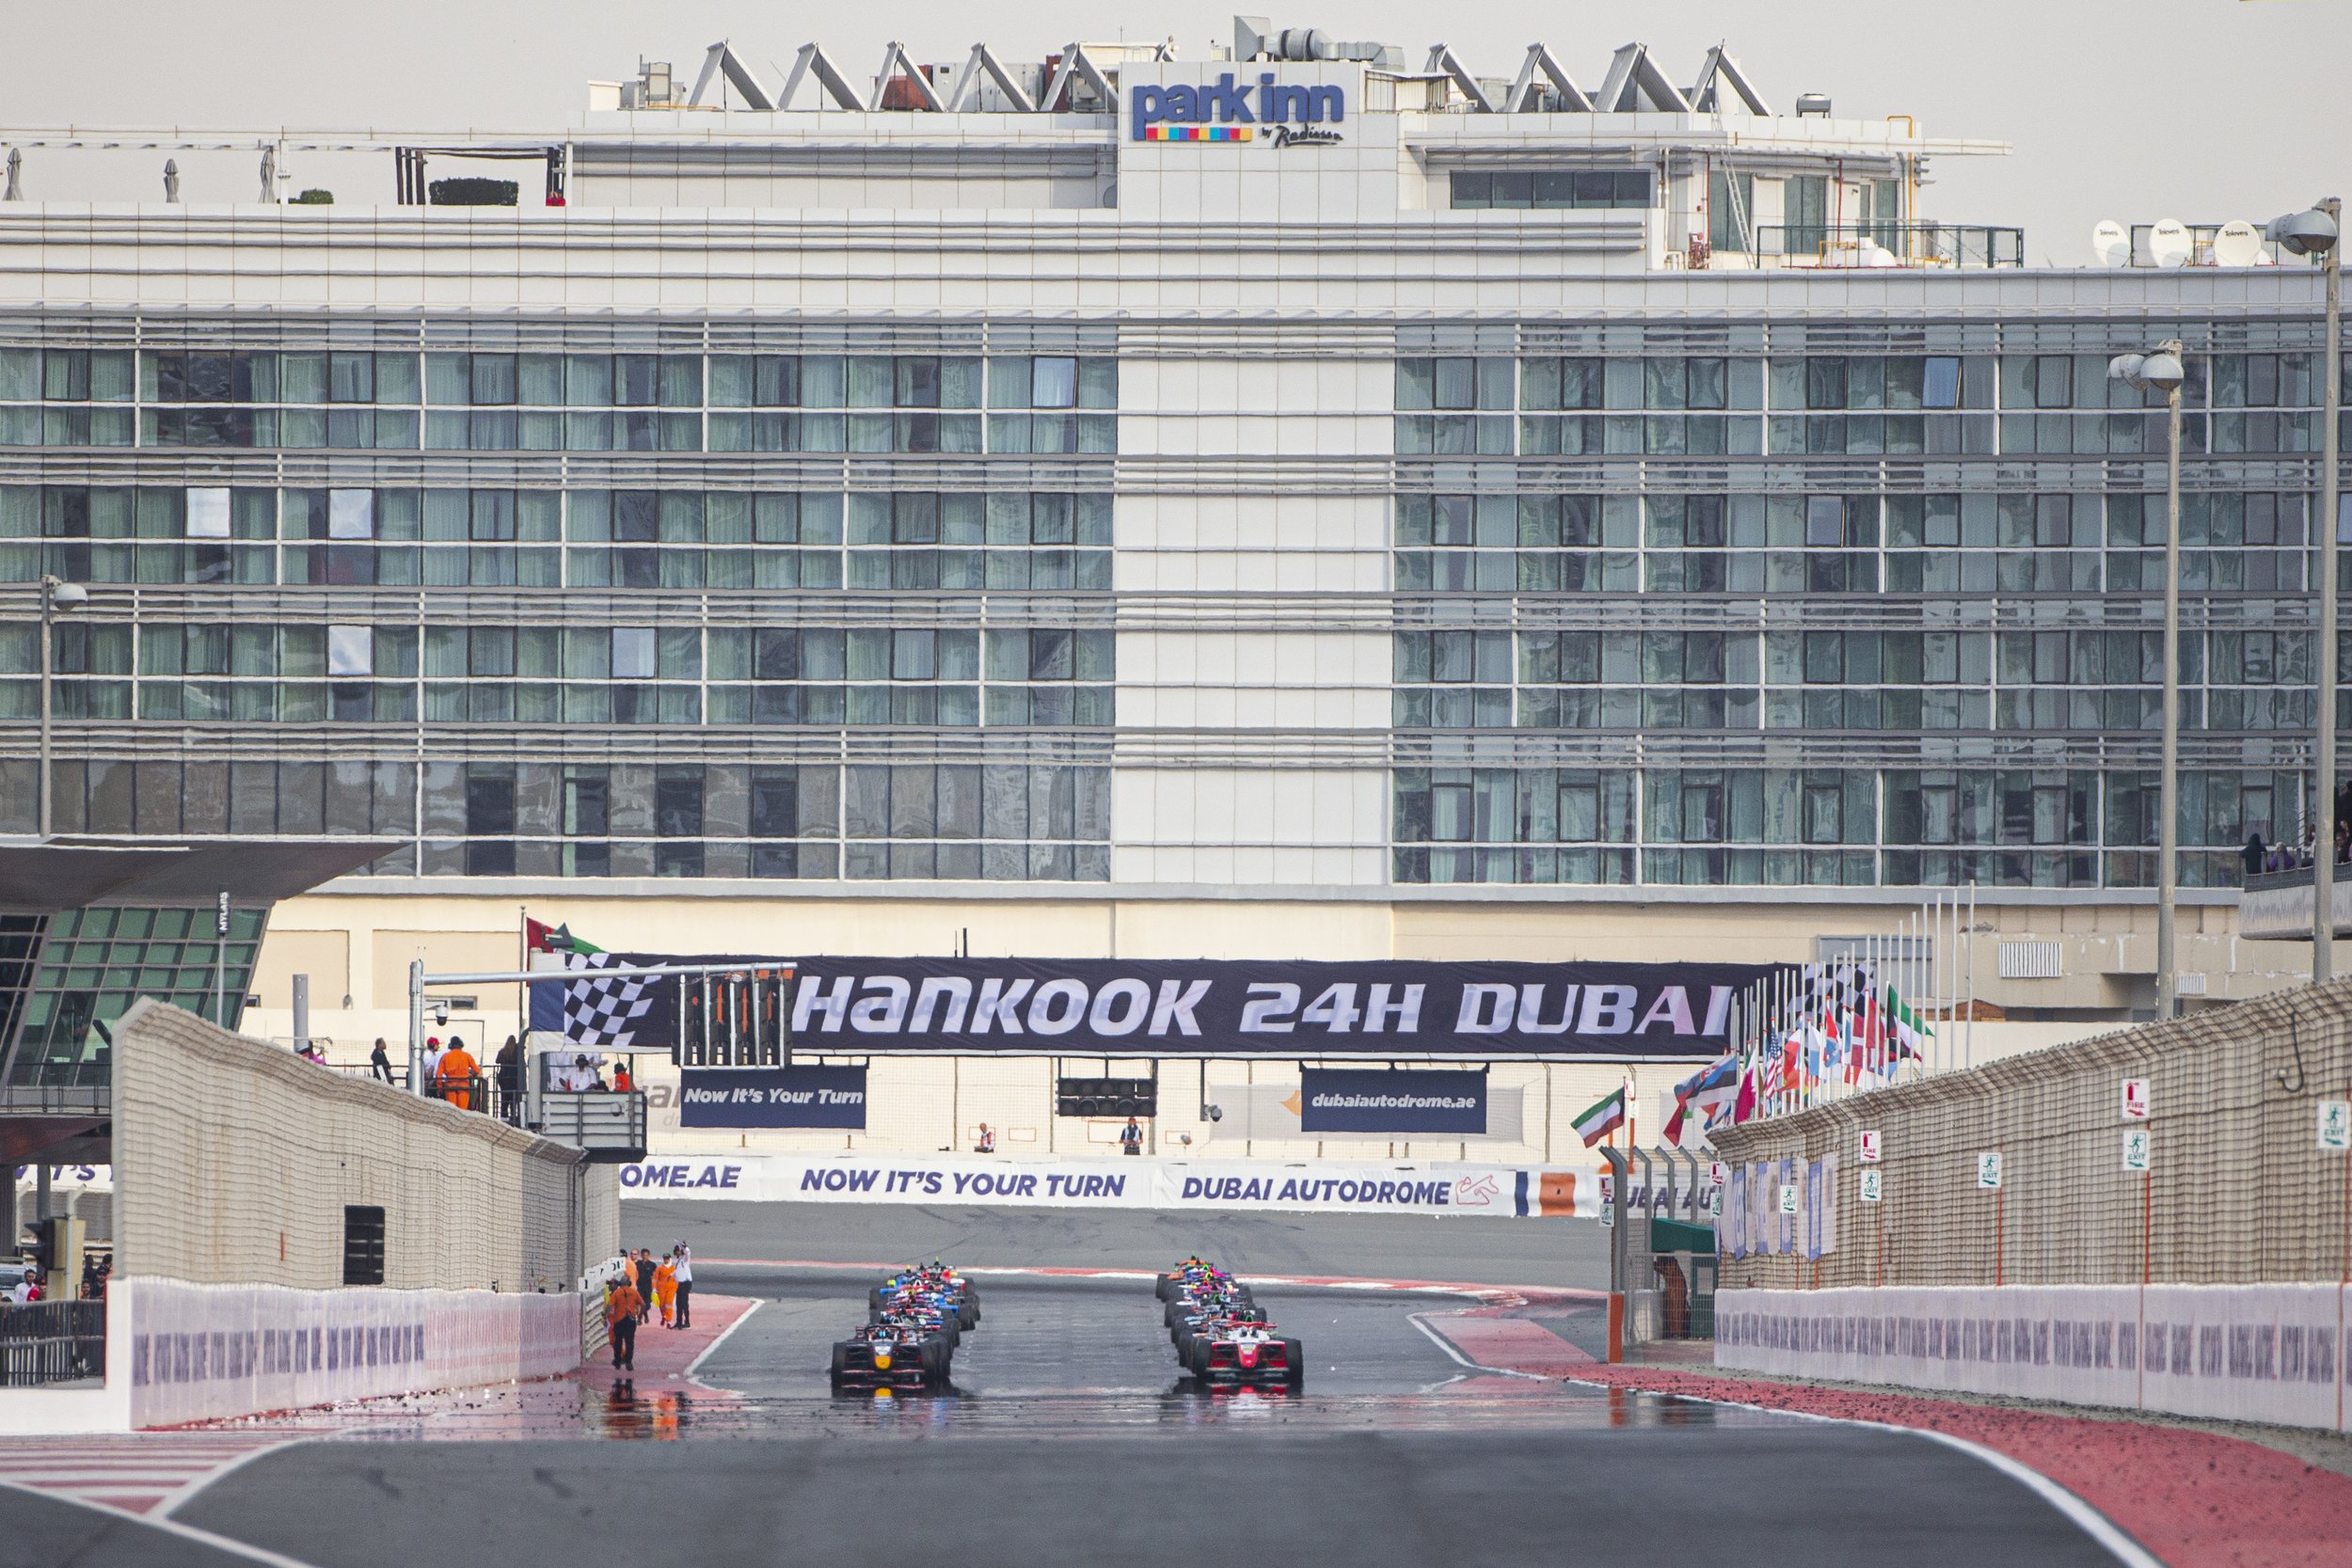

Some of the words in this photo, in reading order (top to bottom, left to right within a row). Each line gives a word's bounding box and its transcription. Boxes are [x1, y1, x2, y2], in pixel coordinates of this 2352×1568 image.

[1133, 72, 1255, 141] park
[1260, 72, 1343, 122] inn
[1261, 127, 1272, 138] by
[1239, 982, 1426, 1034] 24H
[1454, 982, 1734, 1037] DUBAI
[684, 1087, 729, 1103] Now
[732, 1087, 763, 1104] It's
[769, 1087, 813, 1104] Your
[818, 1088, 863, 1105] Turn
[1311, 1093, 1476, 1109] dubaiautodrome.ae
[801, 1168, 880, 1193] NOW
[885, 1169, 944, 1195] IT'S
[952, 1172, 1038, 1196] YOUR
[1045, 1173, 1125, 1198] TURN
[1183, 1177, 1276, 1203] DUBAI
[1278, 1179, 1453, 1205] AUTODROME
